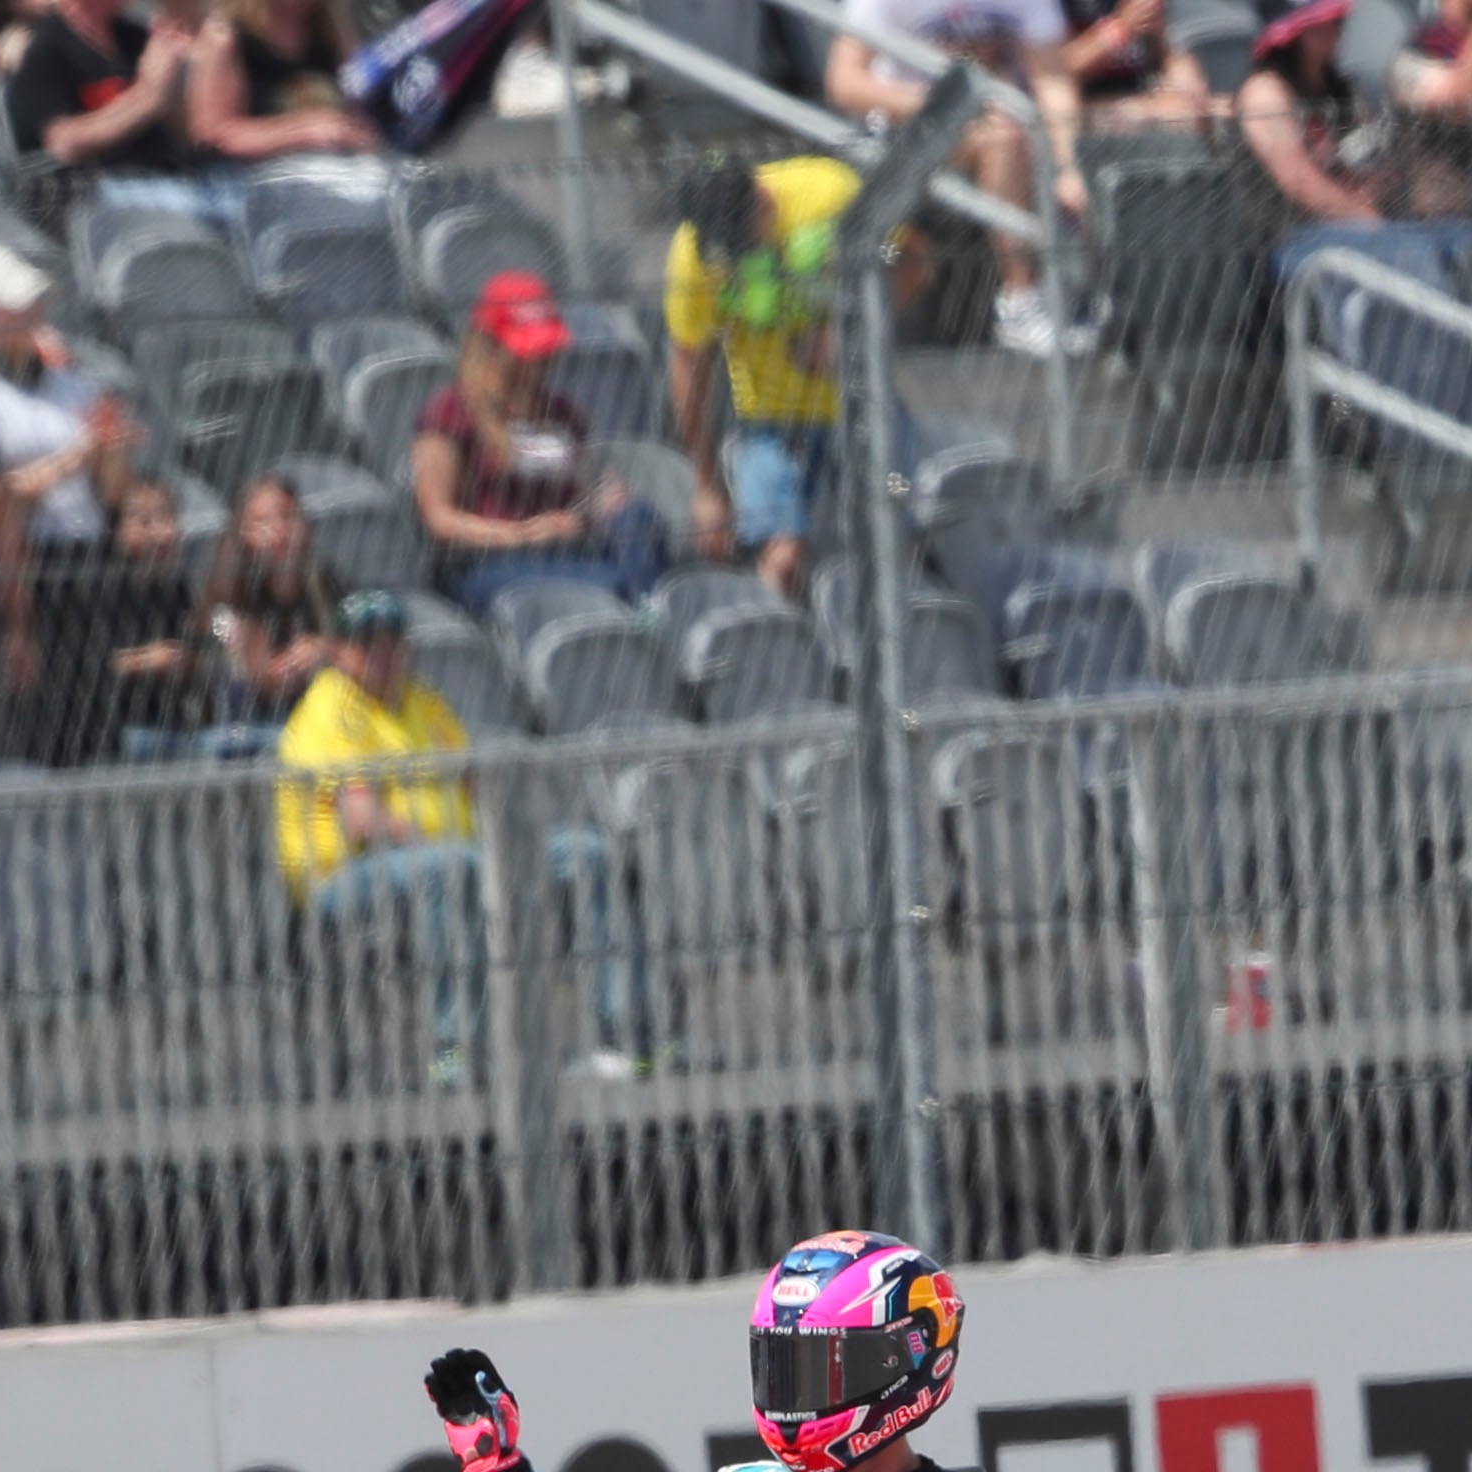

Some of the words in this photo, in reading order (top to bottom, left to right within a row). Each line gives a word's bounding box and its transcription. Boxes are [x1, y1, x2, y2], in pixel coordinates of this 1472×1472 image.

[777, 1284, 810, 1296] BELL
[848, 1413, 894, 1457] Red
[893, 1386, 932, 1430] Bull
